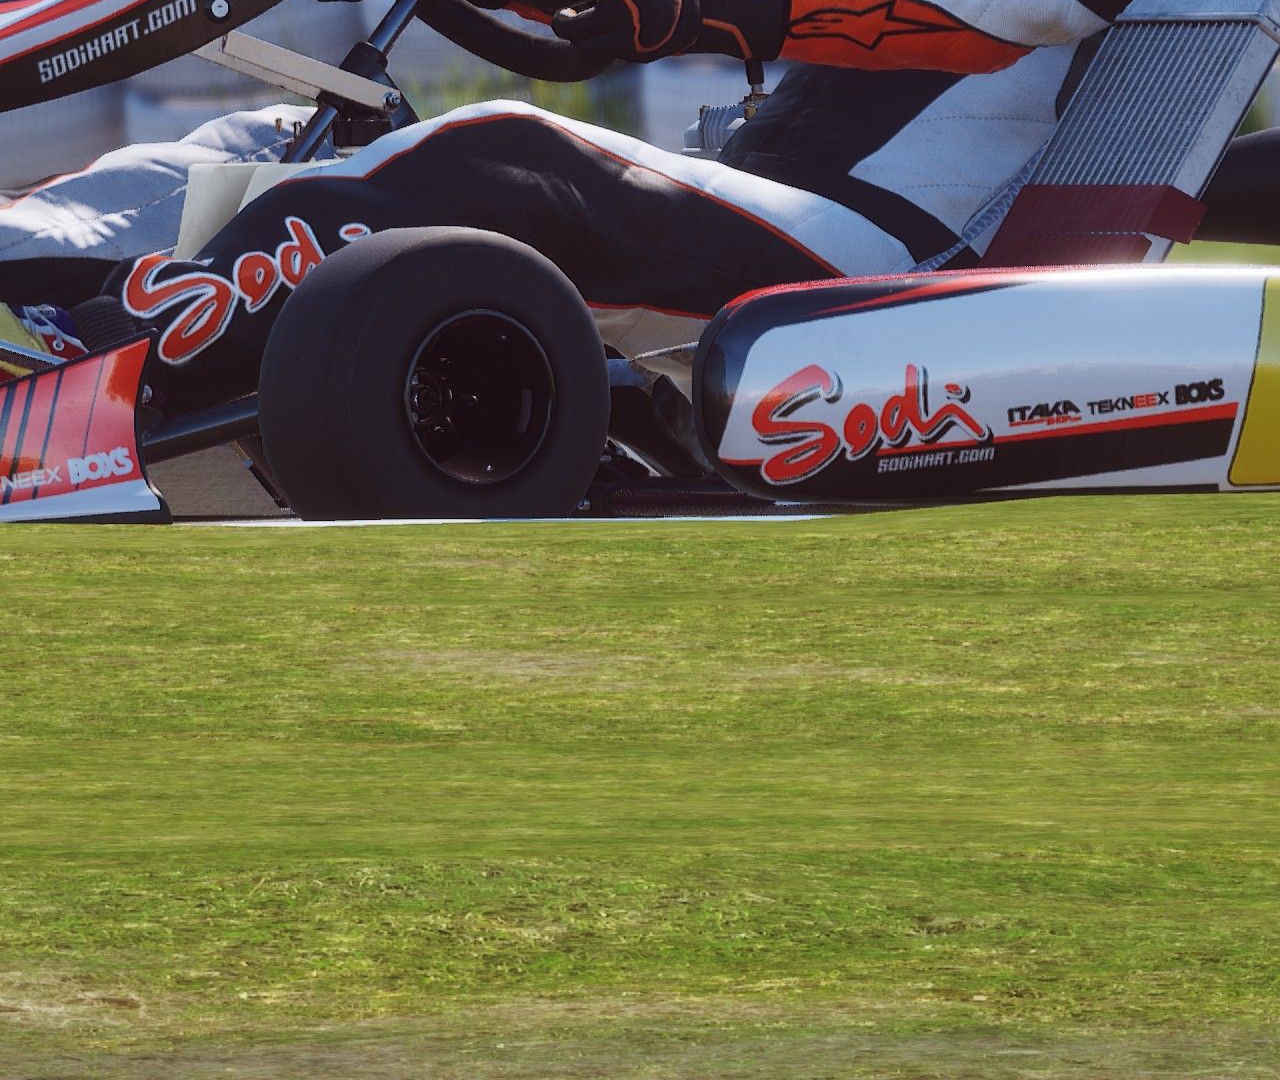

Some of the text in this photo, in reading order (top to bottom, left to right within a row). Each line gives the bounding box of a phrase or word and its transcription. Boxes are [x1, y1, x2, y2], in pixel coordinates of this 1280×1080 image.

[122, 216, 372, 365] Sod
[751, 363, 993, 486] Sodi
[1086, 390, 1170, 415] TEKNEEX
